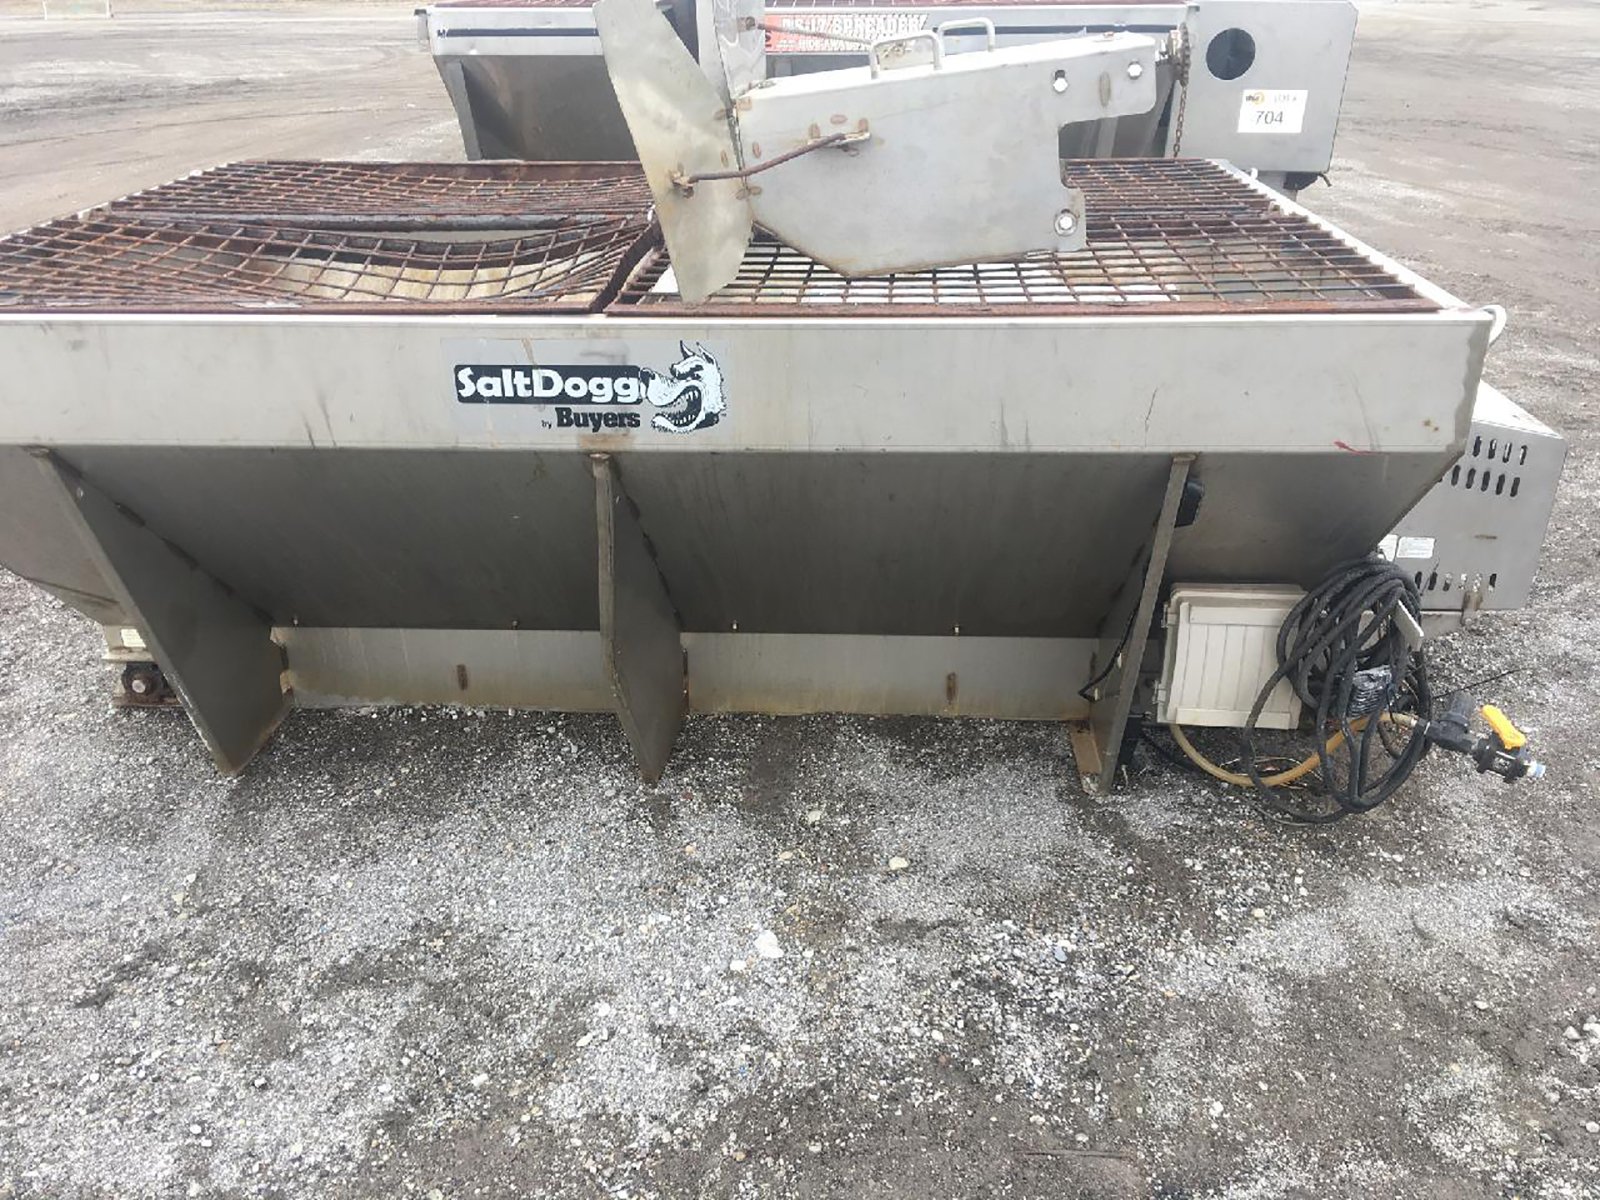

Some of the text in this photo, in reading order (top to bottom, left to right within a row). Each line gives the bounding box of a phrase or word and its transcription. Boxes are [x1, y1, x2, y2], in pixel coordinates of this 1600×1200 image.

[1256, 110, 1284, 125] 704
[457, 367, 640, 404] SaltDogg
[541, 407, 641, 433] by Buyers
